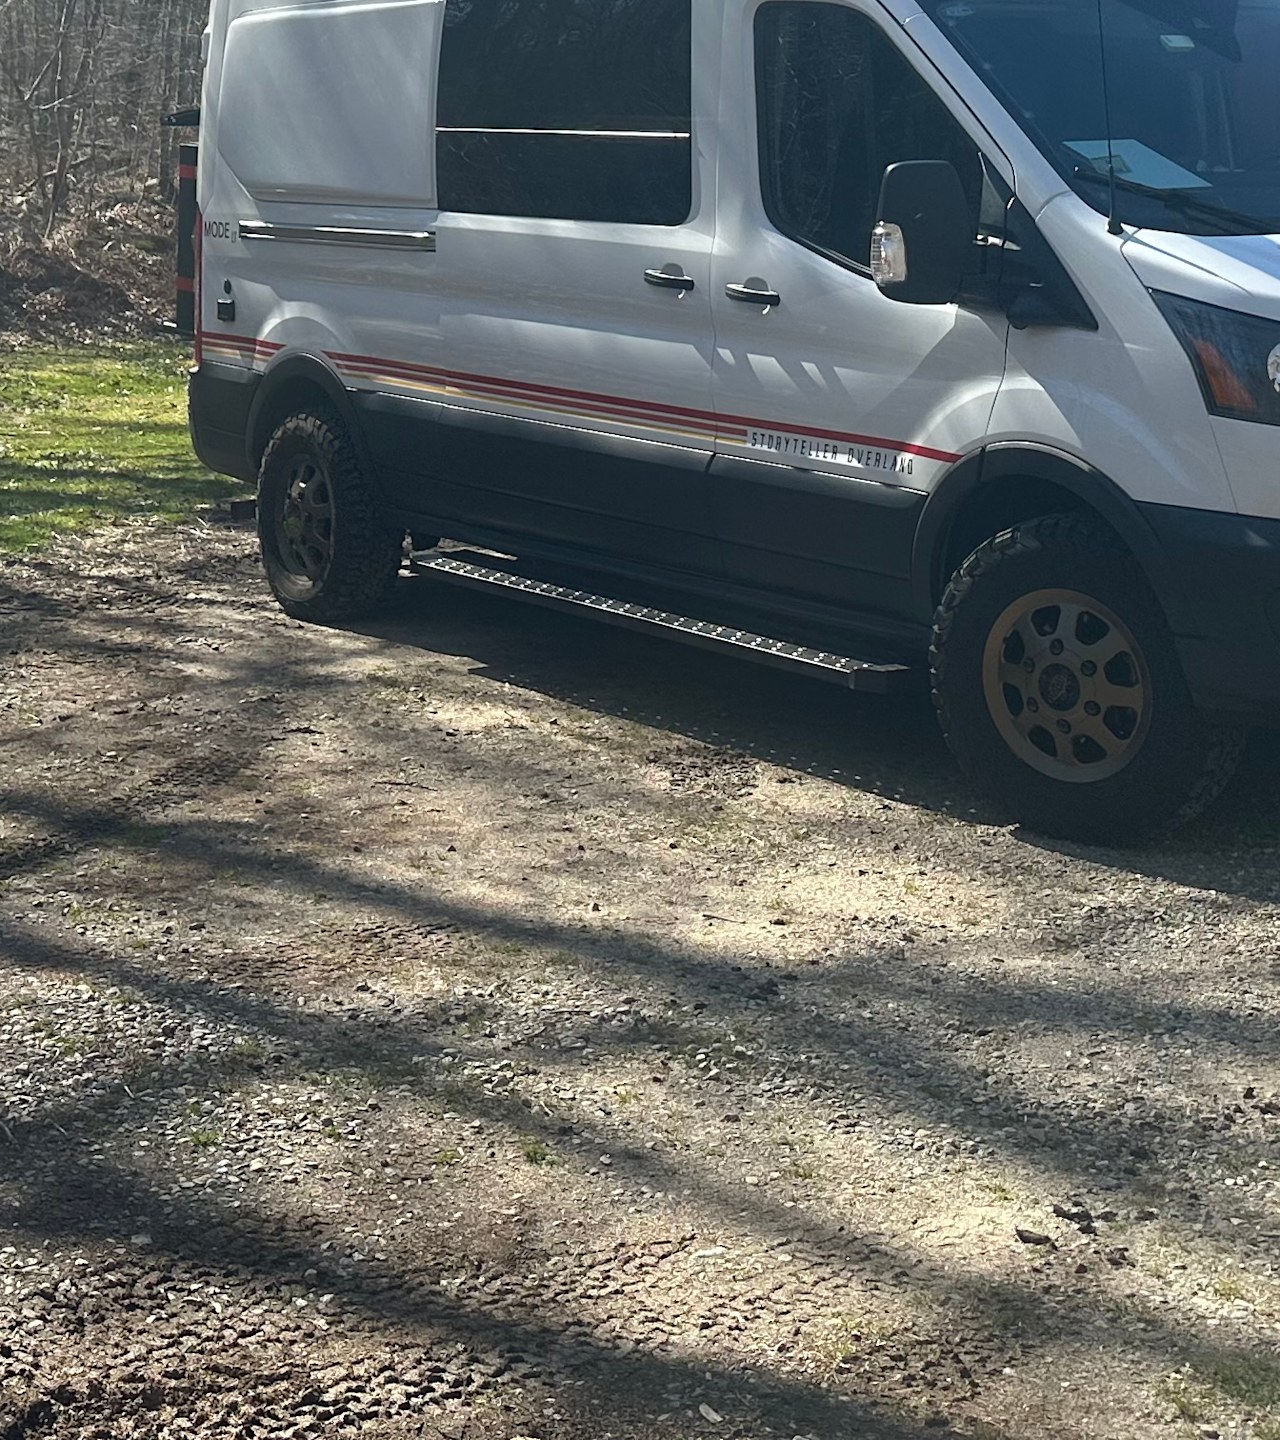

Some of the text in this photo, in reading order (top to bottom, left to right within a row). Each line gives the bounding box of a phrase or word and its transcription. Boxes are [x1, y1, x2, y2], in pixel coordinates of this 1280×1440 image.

[204, 220, 230, 239] MODE
[751, 432, 913, 475] STORYTELLER OVERLAND
